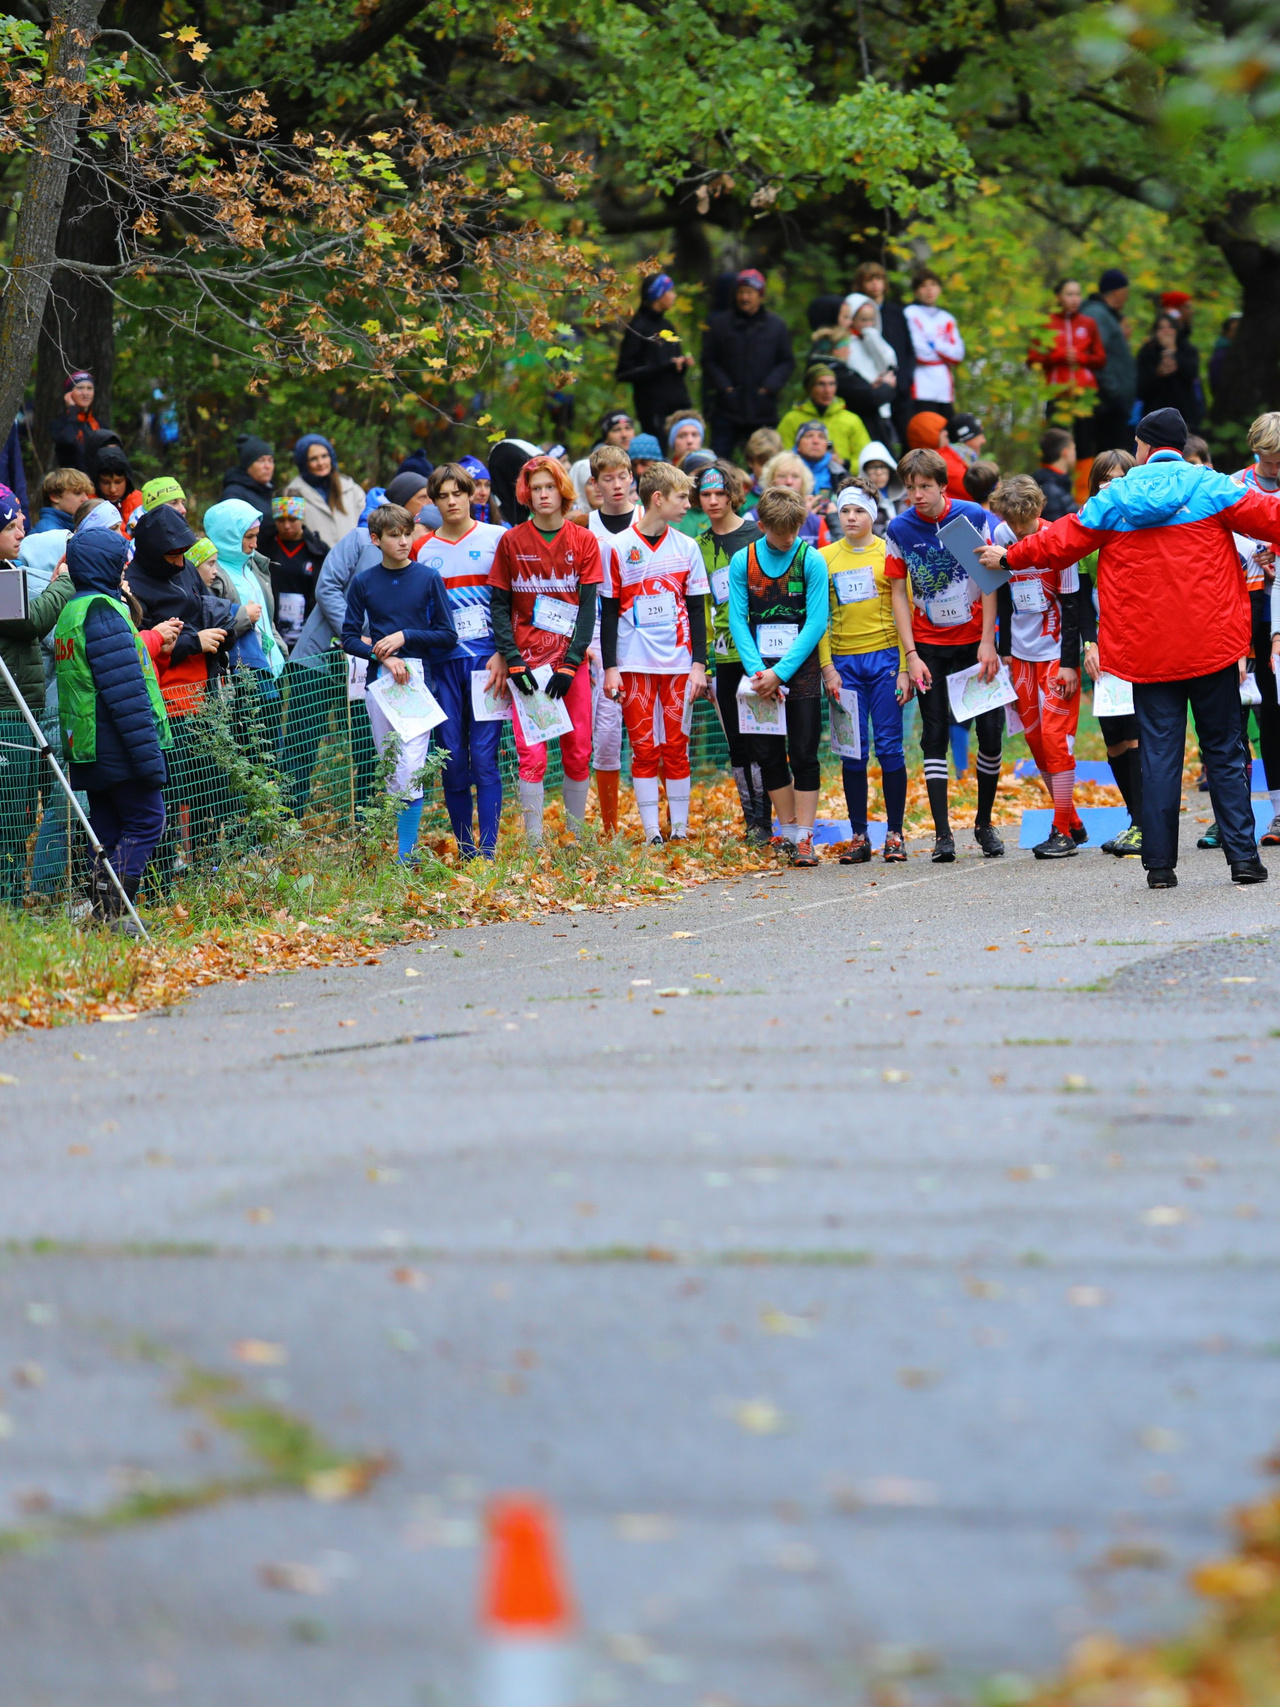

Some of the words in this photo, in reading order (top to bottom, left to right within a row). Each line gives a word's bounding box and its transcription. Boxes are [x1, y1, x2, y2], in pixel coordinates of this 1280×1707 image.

[848, 583, 863, 592] 217
[1019, 594, 1031, 603] 215
[648, 605, 663, 616] 220
[941, 608, 956, 617] 216
[547, 611, 562, 623] 222
[456, 620, 472, 631] 223
[768, 638, 783, 647] 218
